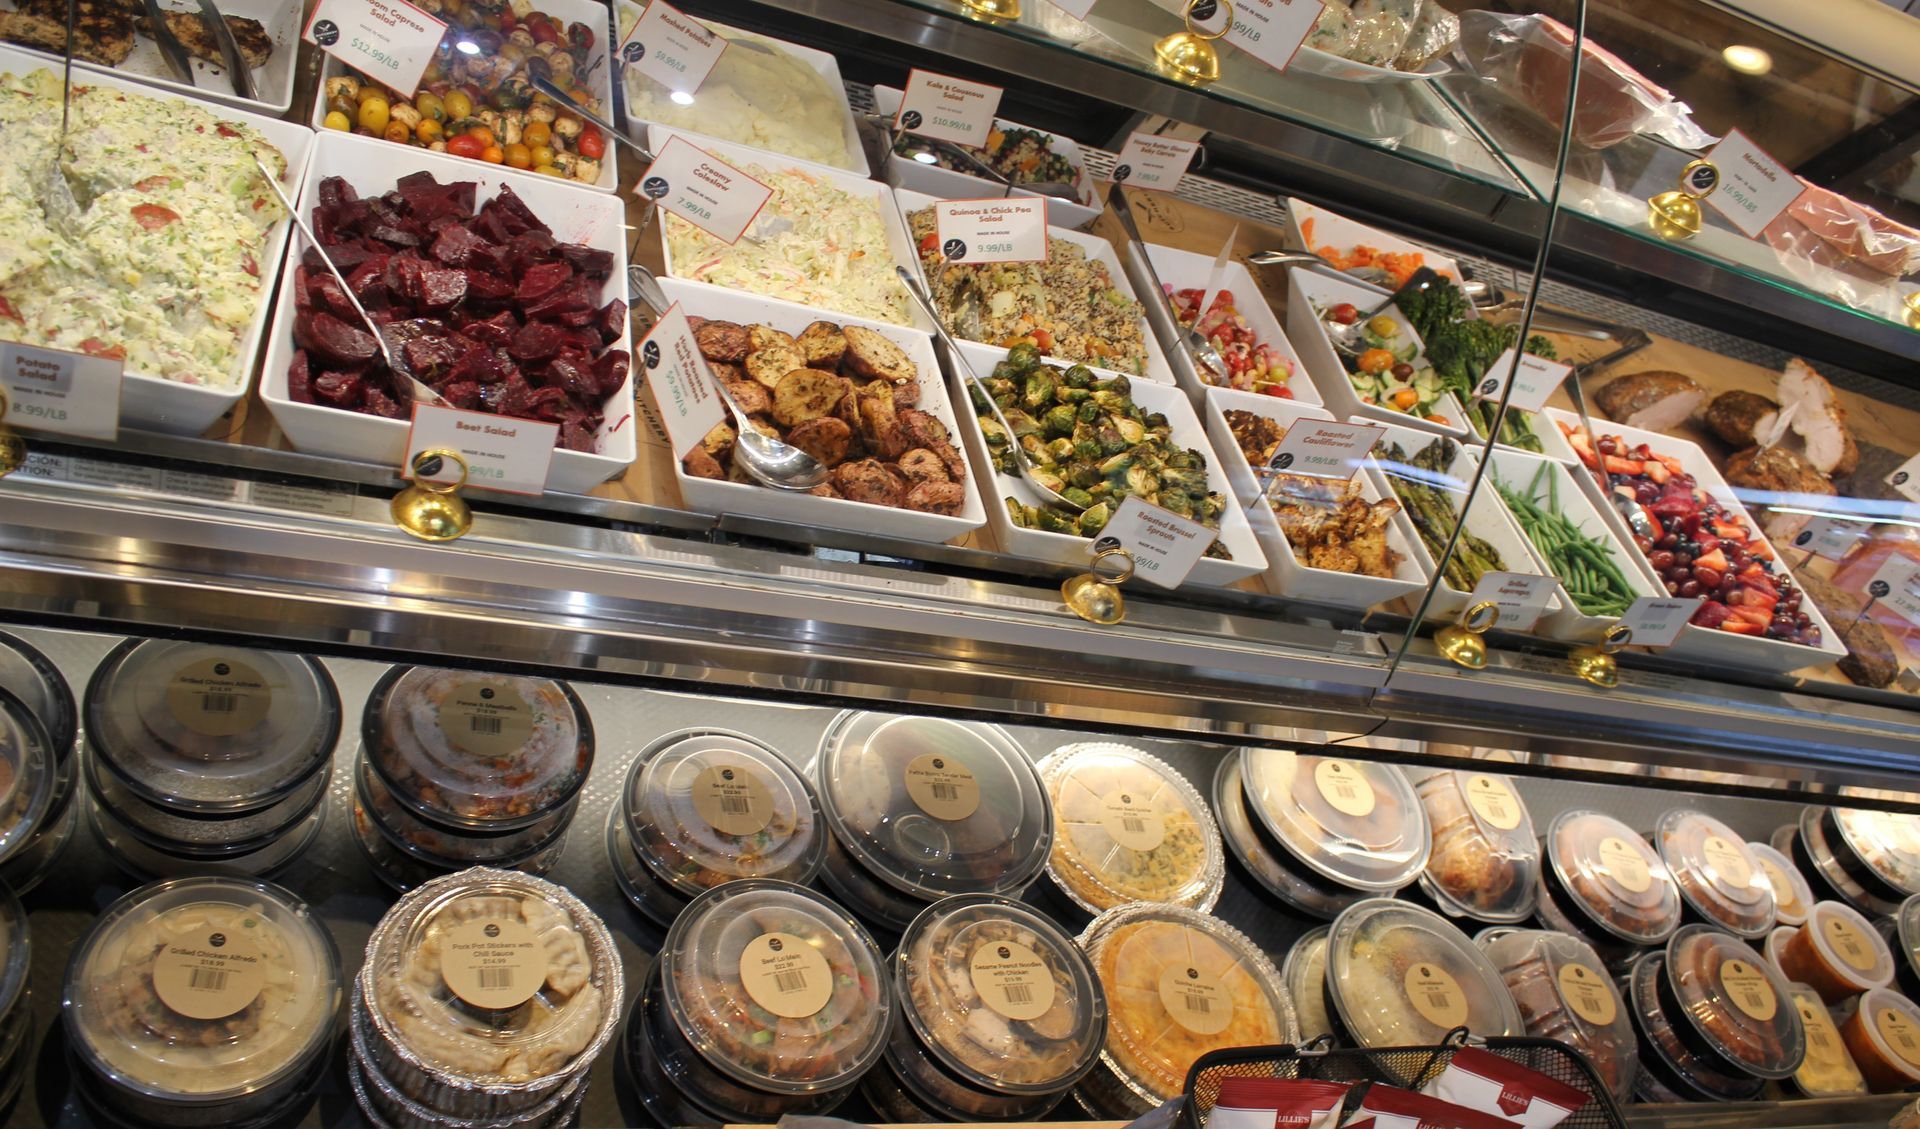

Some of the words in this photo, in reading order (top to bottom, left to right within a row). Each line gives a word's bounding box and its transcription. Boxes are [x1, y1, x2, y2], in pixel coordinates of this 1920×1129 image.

[369, 8, 397, 27] Salad
[390, 9, 425, 33] Caprese
[660, 13, 685, 32] Mashed
[351, 38, 400, 70] $12.99/LB
[926, 81, 943, 89] Kale
[943, 92, 965, 102] Salad
[693, 168, 730, 192] Coleslaw
[700, 163, 732, 183] Creamy
[678, 196, 712, 220] 7.99/LB
[950, 209, 981, 217] Quinoa
[991, 206, 1013, 215] Chick
[1015, 206, 1032, 214] Pea
[979, 214, 1003, 223] Salad
[977, 243, 1013, 253] 9.99/LB
[674, 342, 685, 362] Red
[16, 355, 61, 371] Potato
[18, 367, 57, 382] Salad
[12, 402, 67, 420] 8.99/LB
[456, 421, 481, 432] Beet
[484, 425, 517, 438] Salad
[1315, 429, 1354, 440] Roasted
[1303, 436, 1355, 449] Cauliflower
[28, 454, 61, 467] CIÓN:
[1137, 511, 1169, 529] Roasted
[1168, 521, 1197, 540] Brussel
[1146, 525, 1176, 541] Sprouts
[171, 948, 196, 957] Grilled
[197, 950, 229, 960] Chicken
[229, 954, 257, 963] Alfredo
[200, 959, 225, 967] $18.99
[761, 956, 776, 965] Beef
[785, 953, 802, 961] Mein
[974, 963, 997, 971] Sesame
[1501, 1091, 1530, 1106] LILLIE'S
[1278, 1115, 1311, 1124] LILLIE'S
